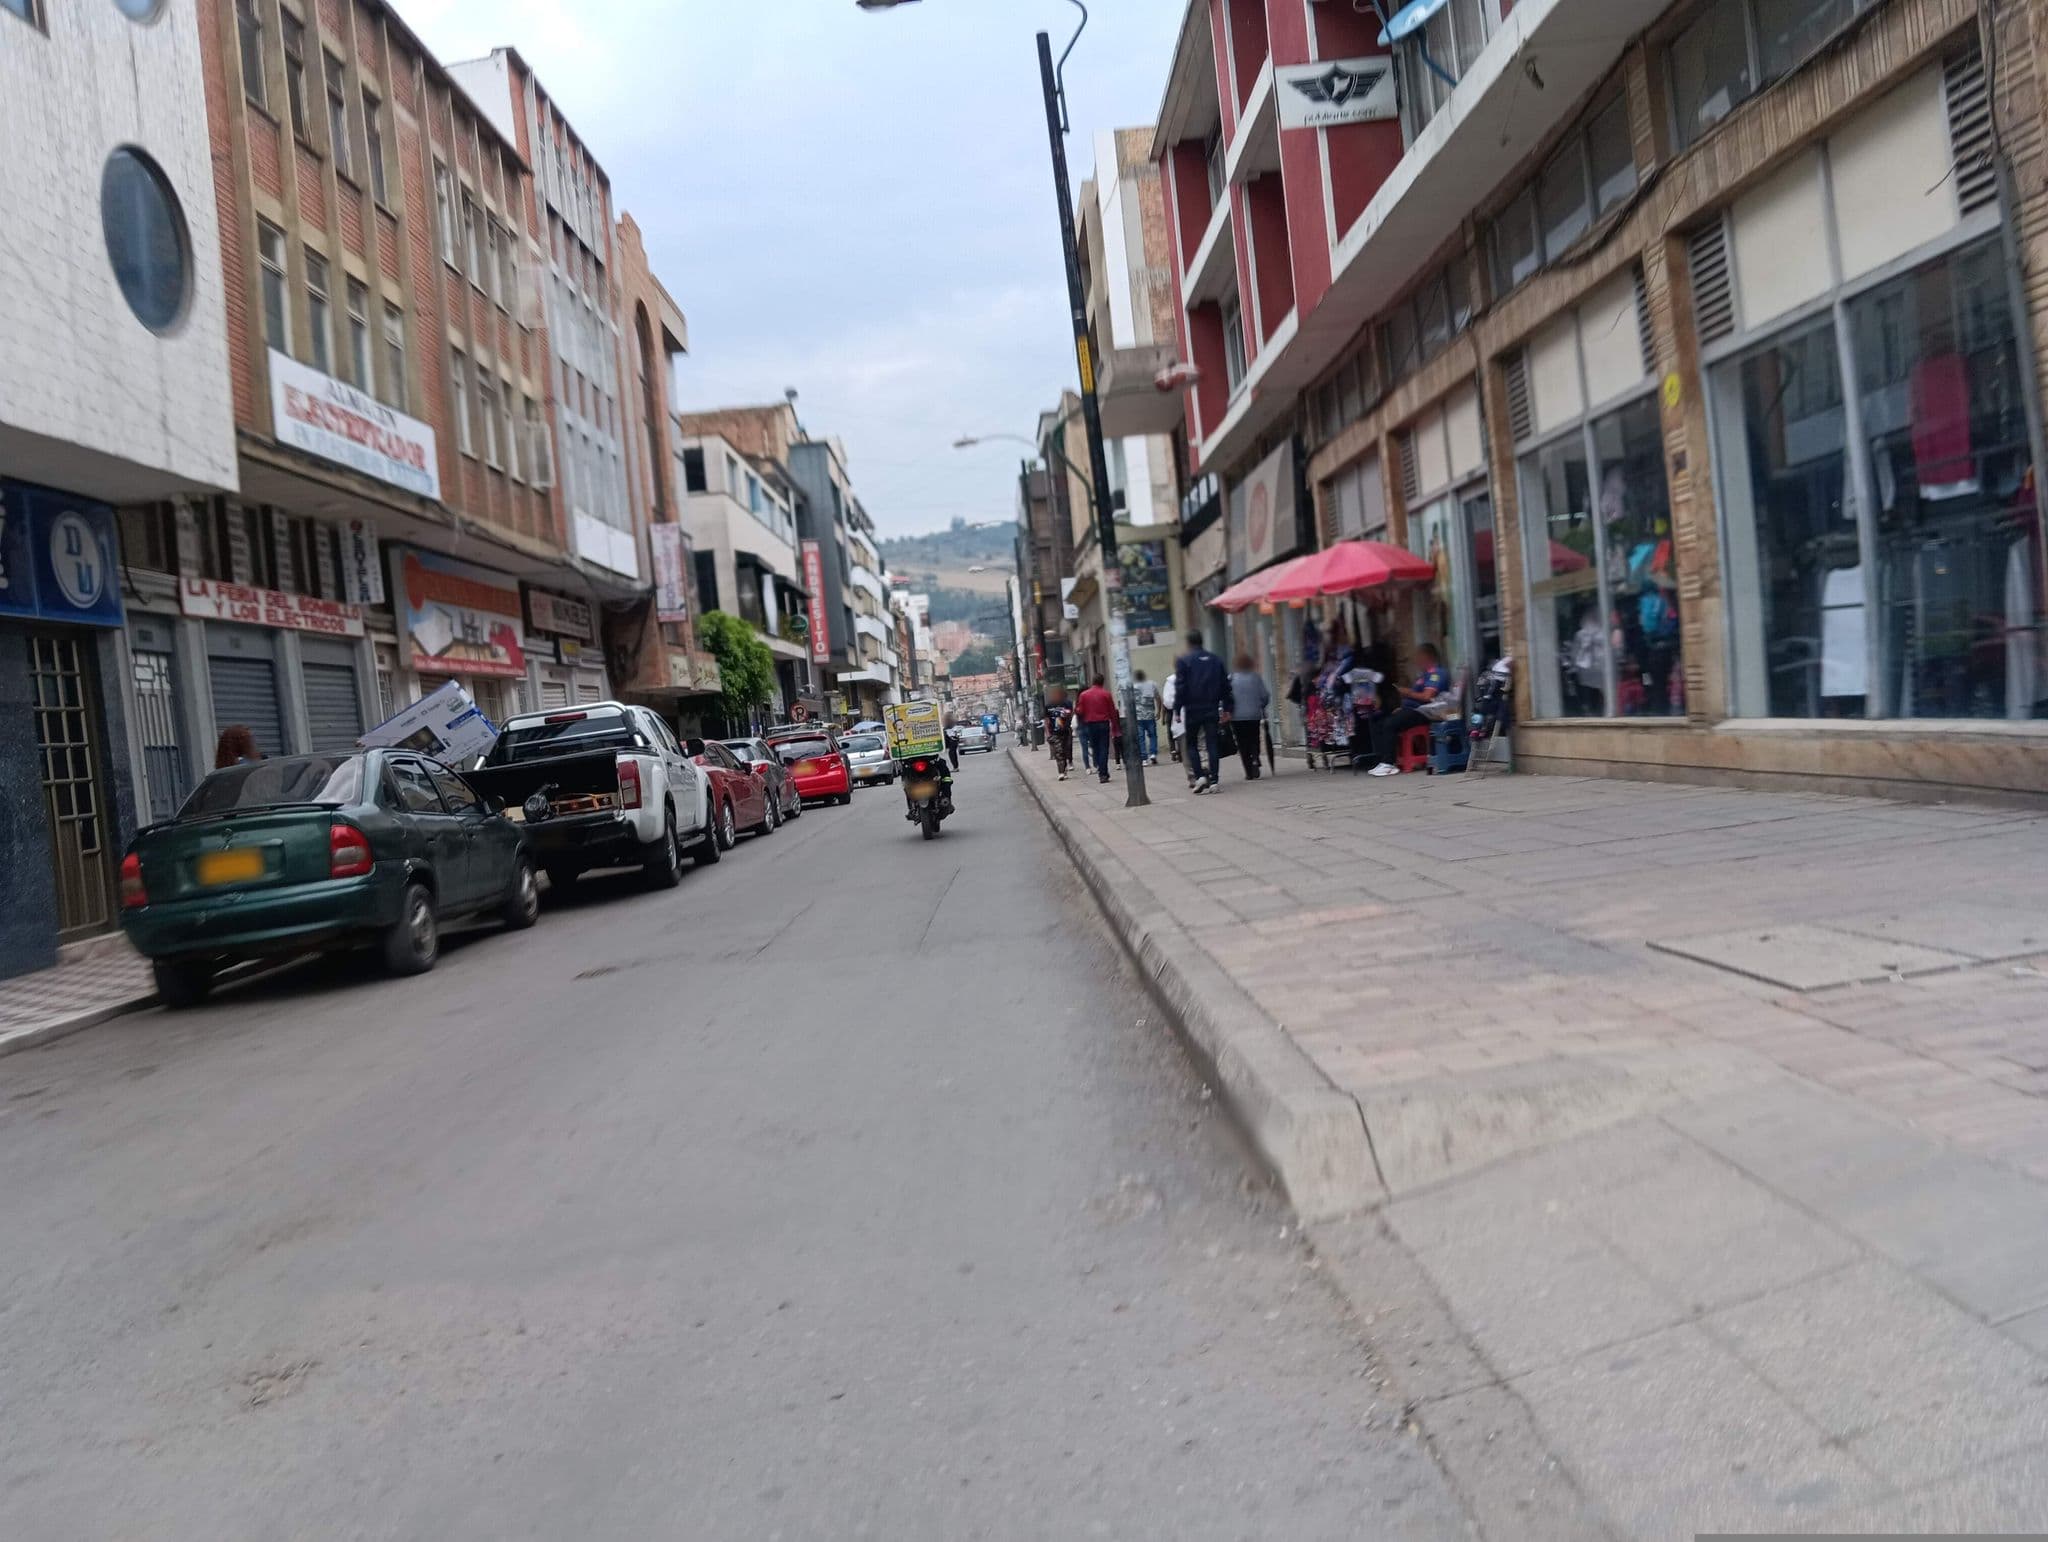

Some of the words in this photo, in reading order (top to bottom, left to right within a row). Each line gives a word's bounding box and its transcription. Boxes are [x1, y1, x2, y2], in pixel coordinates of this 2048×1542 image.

[187, 579, 210, 597] LA
[216, 583, 260, 606] FERIA
[265, 590, 291, 610] DEL
[213, 601, 224, 616] Y
[231, 603, 260, 621] LOS
[265, 608, 346, 632] ELECTRICOS
